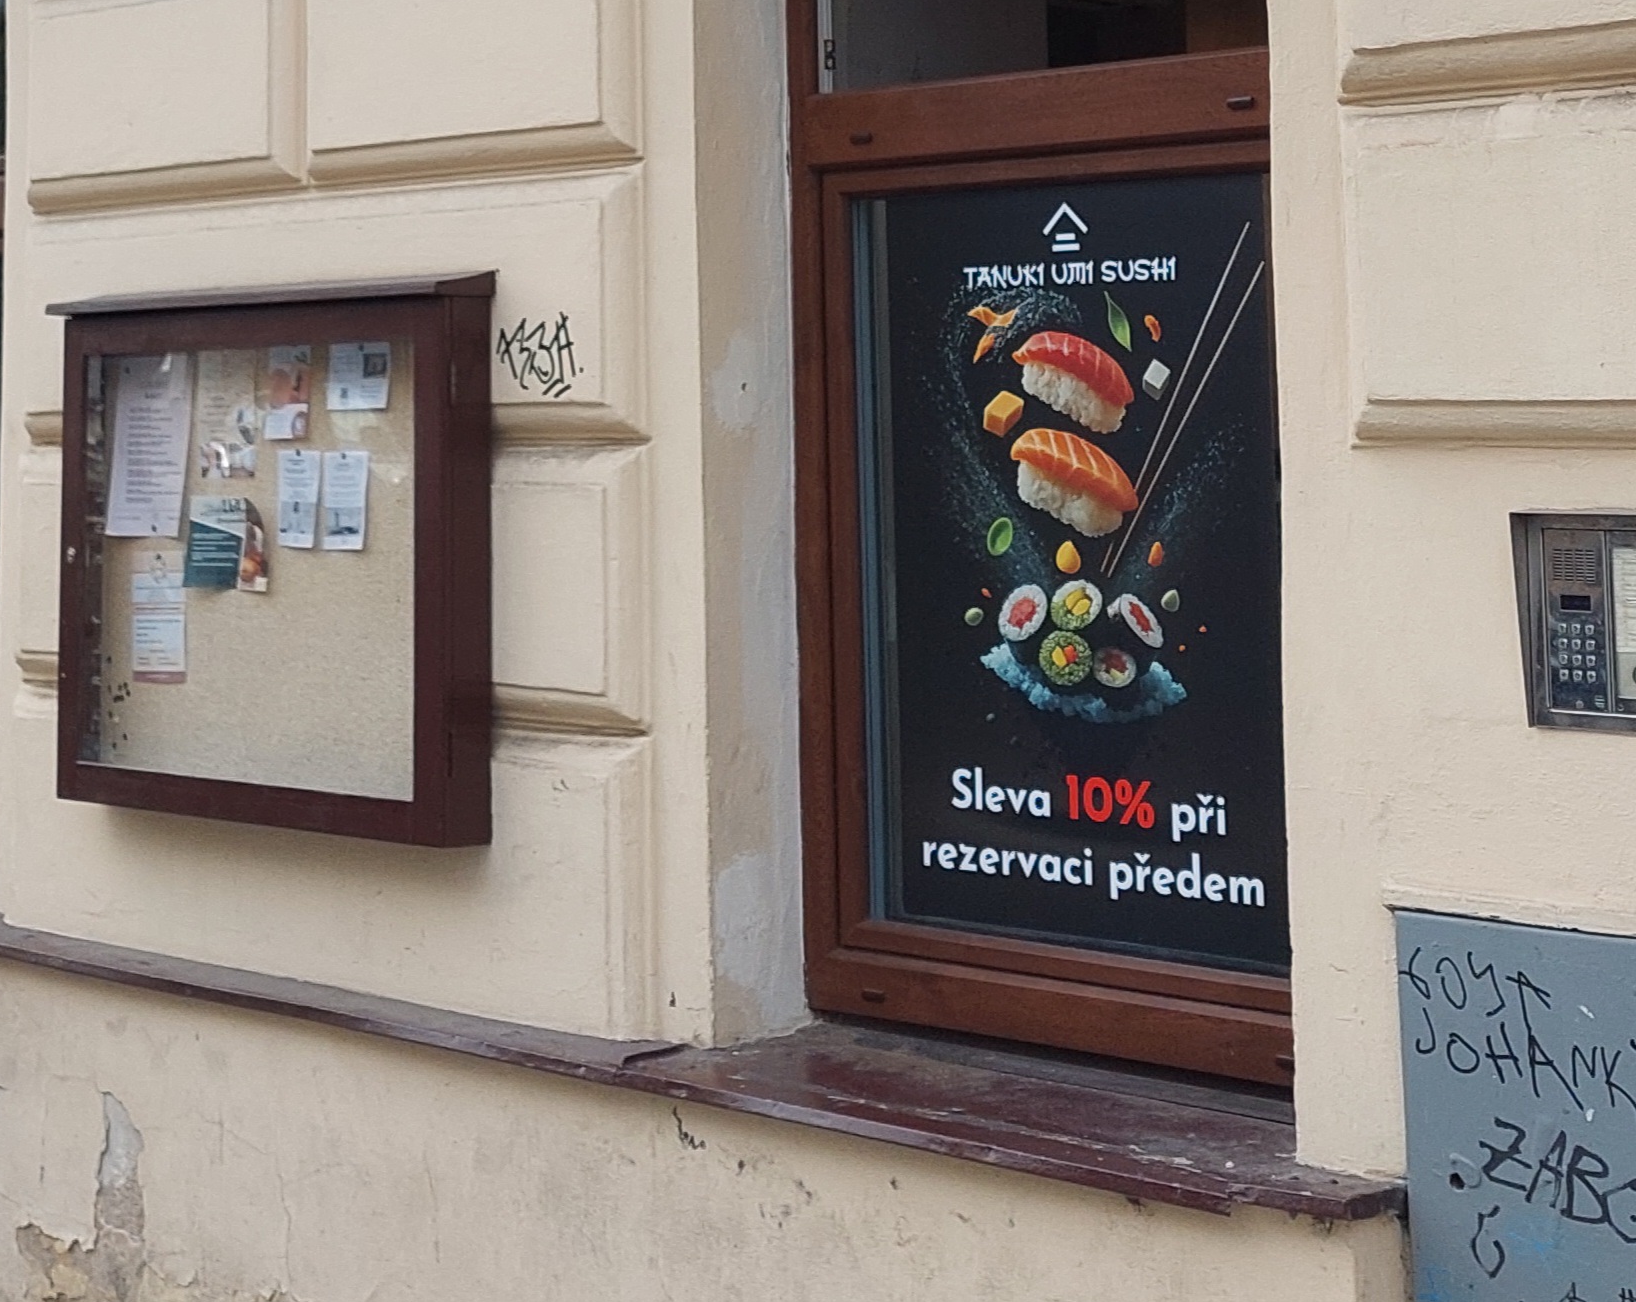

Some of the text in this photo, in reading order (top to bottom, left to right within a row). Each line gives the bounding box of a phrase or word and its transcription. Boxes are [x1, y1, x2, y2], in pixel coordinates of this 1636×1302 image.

[962, 255, 1177, 290] TANUKI UMI SUSHI
[950, 766, 1227, 843] Sleva 10% při
[922, 840, 1266, 907] rezervaci předem
[1415, 1007, 1636, 1111] JOHANK
